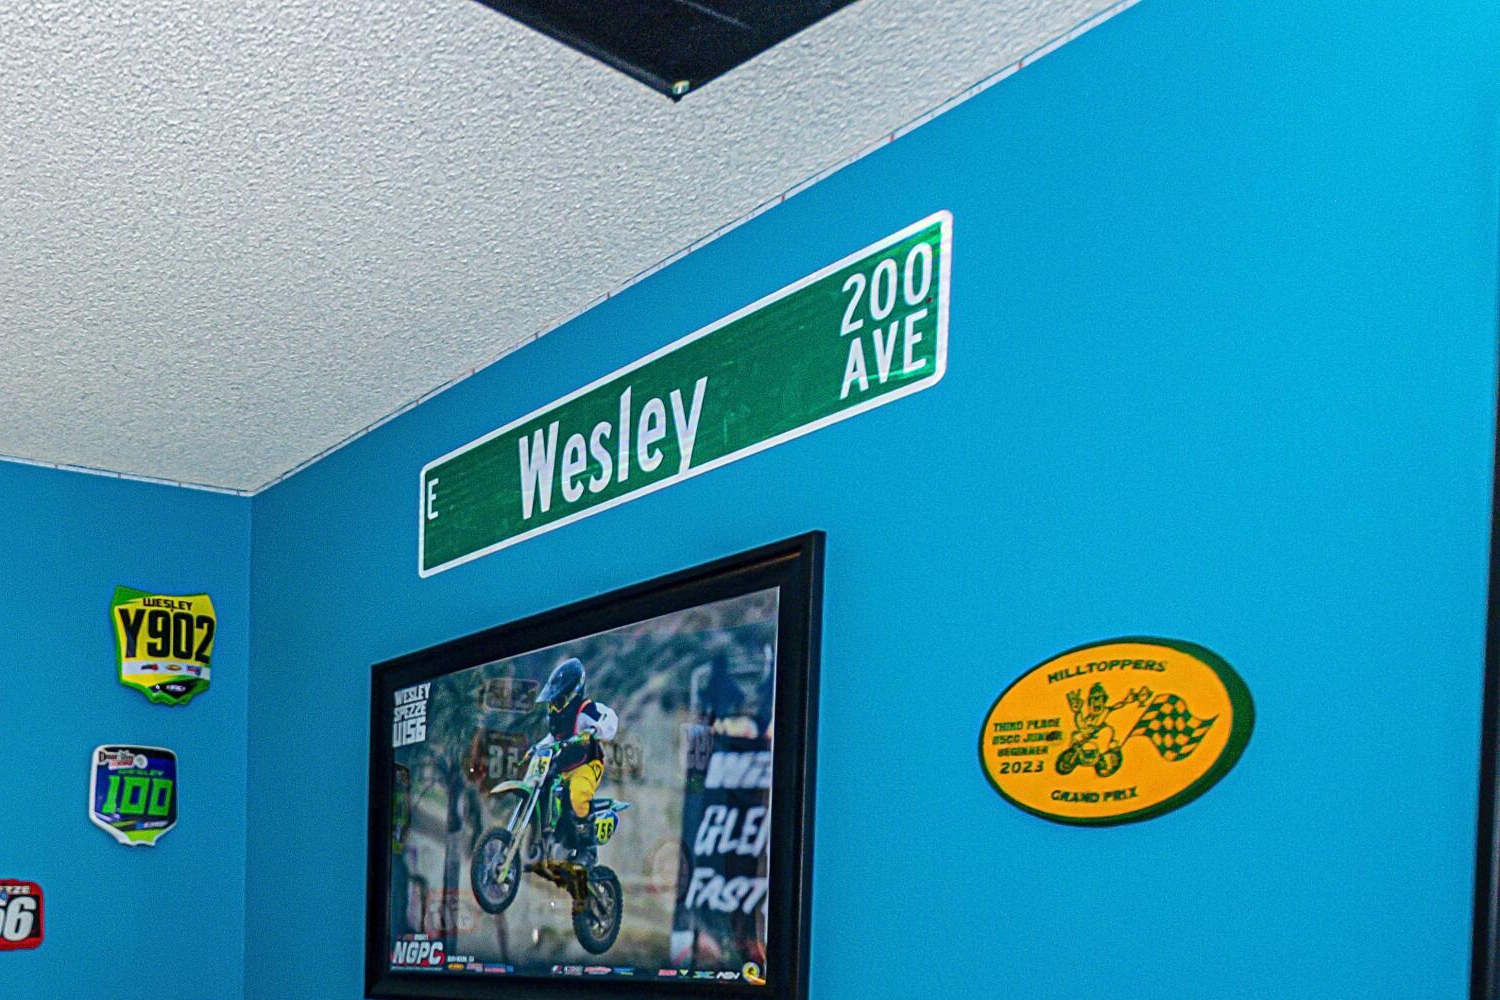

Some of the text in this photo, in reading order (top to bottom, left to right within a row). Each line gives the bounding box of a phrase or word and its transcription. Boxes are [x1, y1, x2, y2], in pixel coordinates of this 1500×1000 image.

[840, 242, 932, 337] 200
[839, 309, 928, 400] AVE
[427, 376, 708, 520] E Wesley
[143, 598, 193, 611] WESLEY
[119, 608, 215, 664] Y902
[394, 682, 431, 706] WESLEY
[394, 700, 427, 722] SPEZZE
[393, 716, 426, 748] U156
[1000, 760, 1044, 774] 2023
[102, 775, 173, 816] 100
[1051, 786, 1139, 803] GRAND PRIX
[392, 941, 444, 965] NGPC
